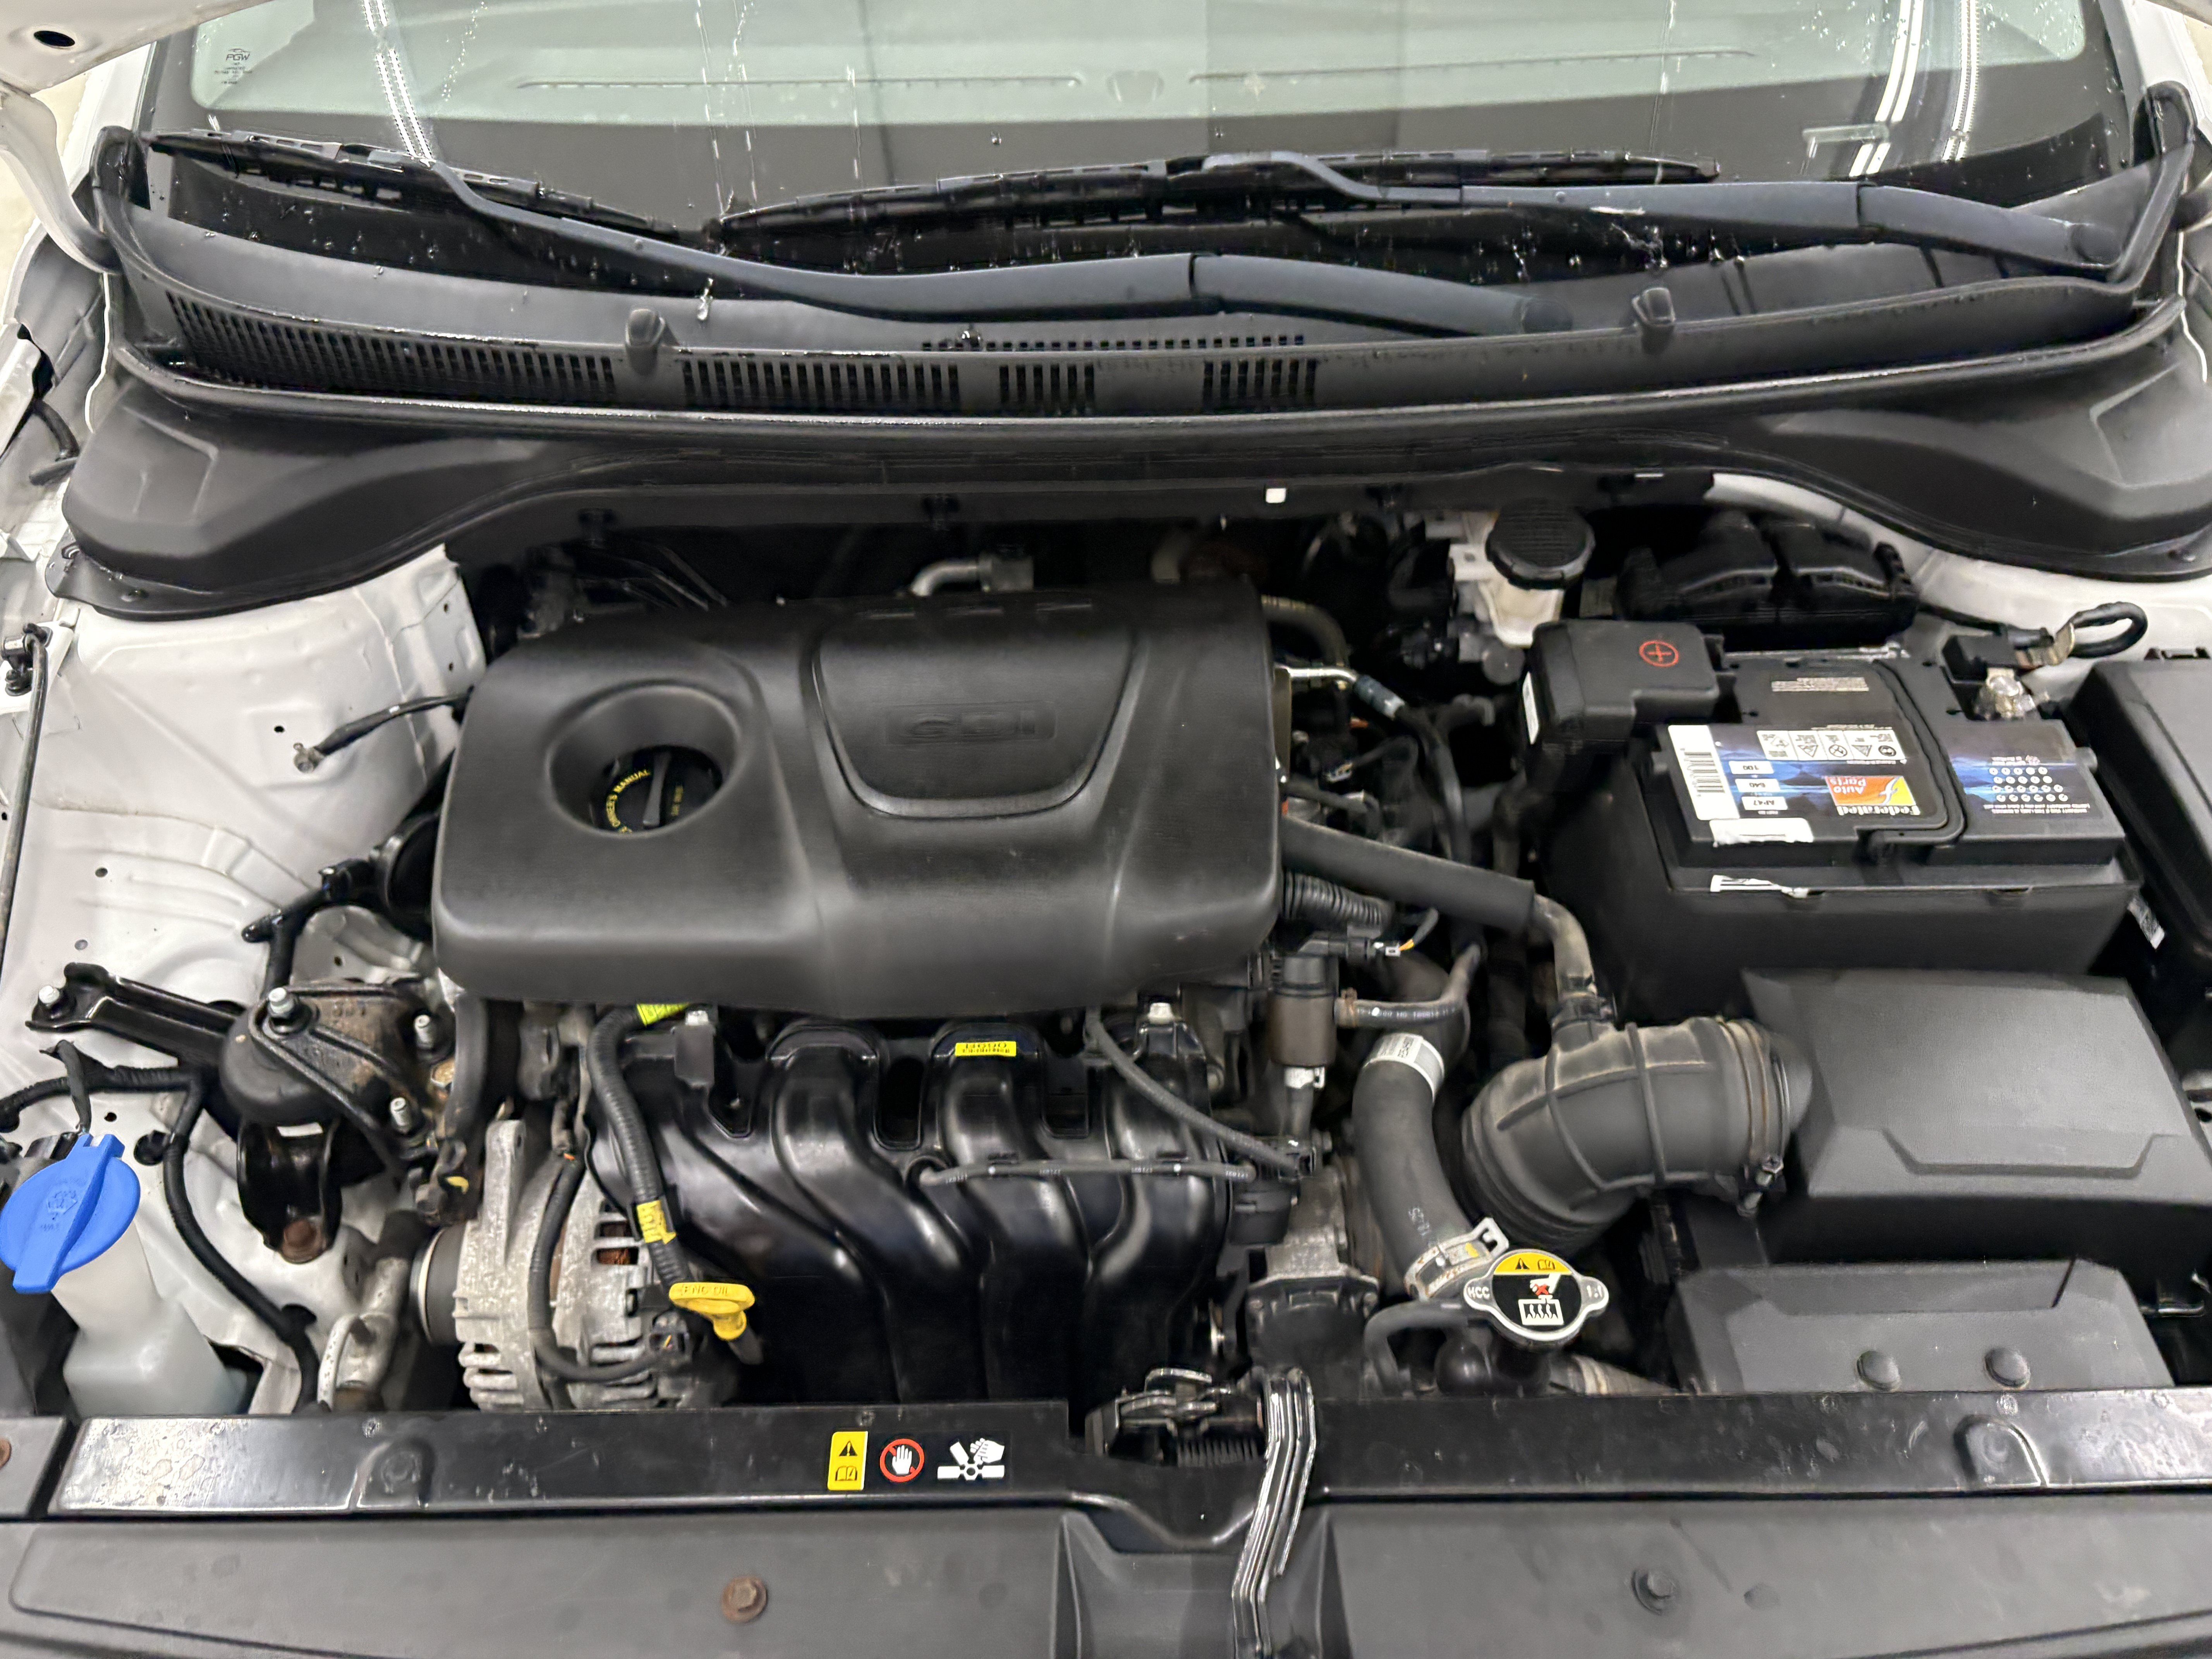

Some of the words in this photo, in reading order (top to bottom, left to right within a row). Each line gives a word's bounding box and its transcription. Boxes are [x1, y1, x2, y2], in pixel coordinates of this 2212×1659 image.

[1829, 778, 1866, 787] Parts
[1833, 786, 1864, 795] Auto
[1836, 805, 1920, 816] Federated
